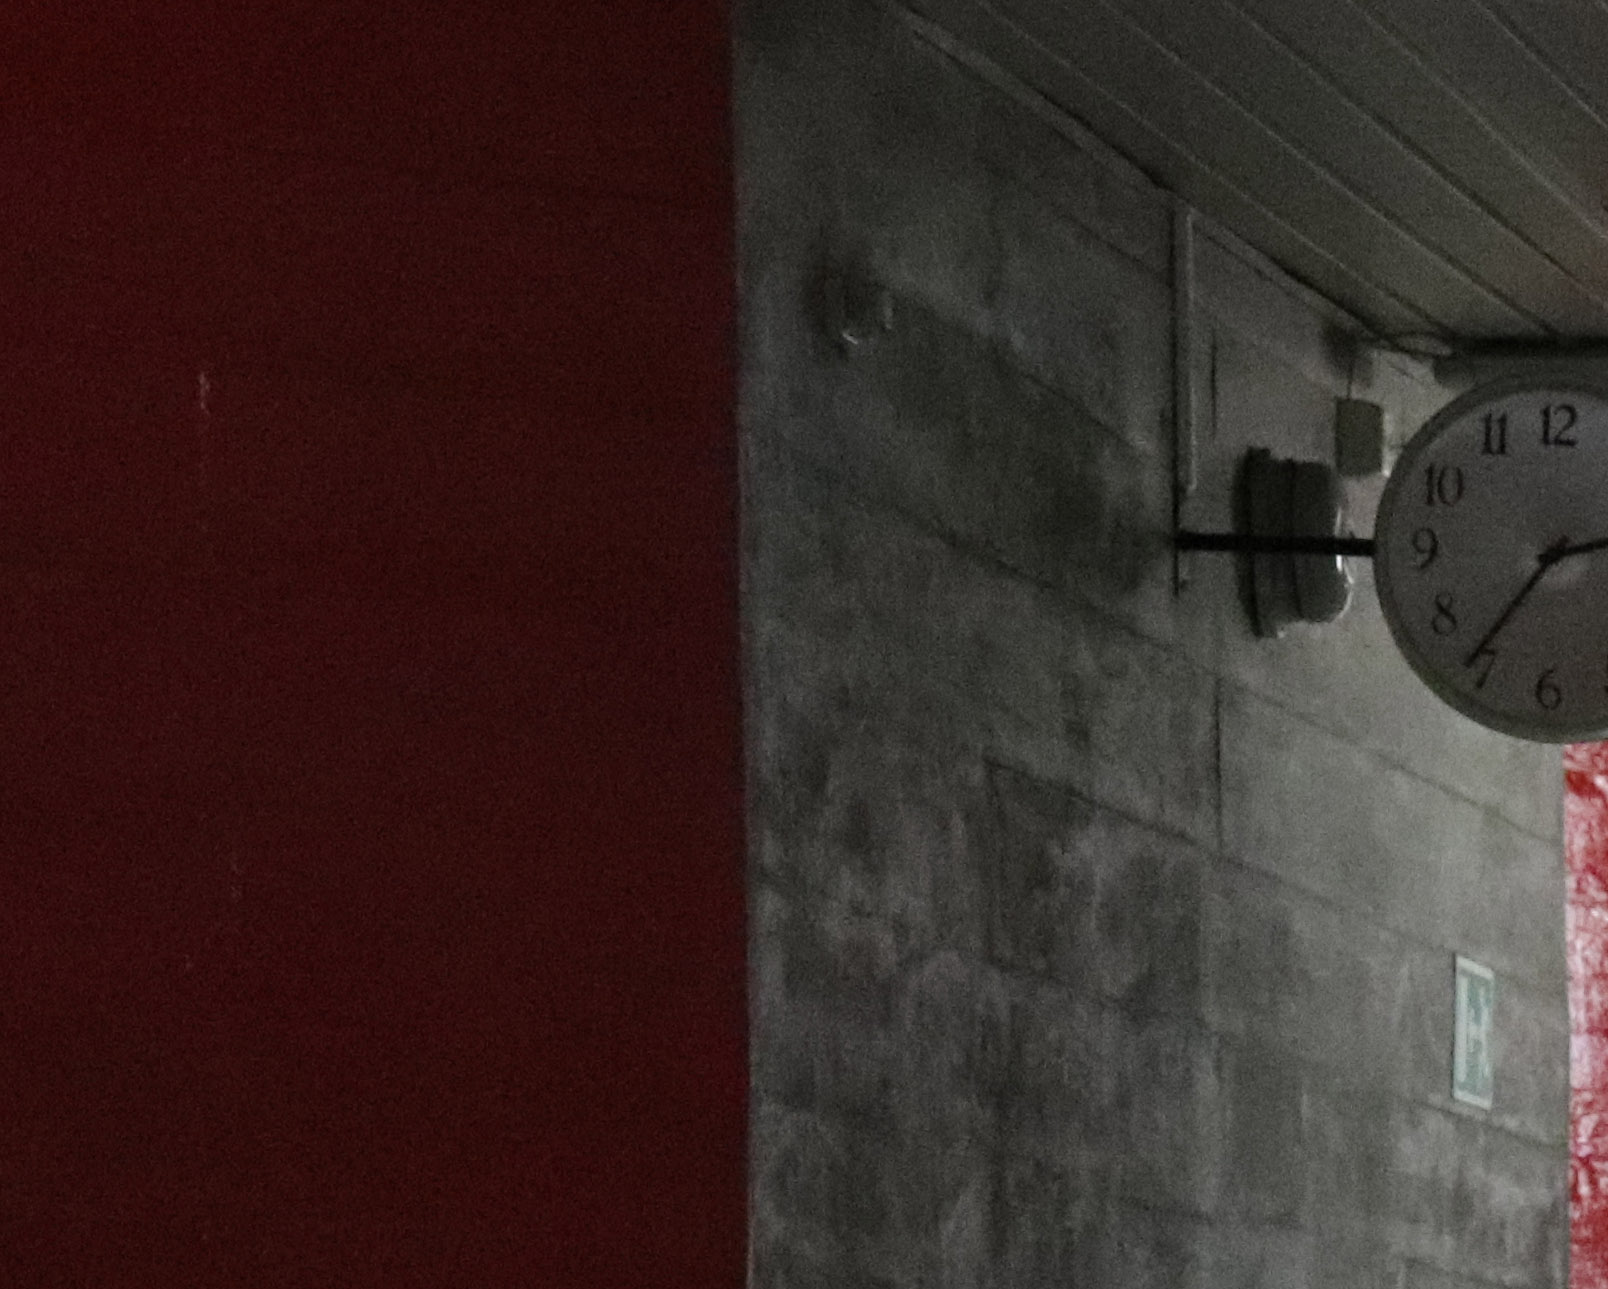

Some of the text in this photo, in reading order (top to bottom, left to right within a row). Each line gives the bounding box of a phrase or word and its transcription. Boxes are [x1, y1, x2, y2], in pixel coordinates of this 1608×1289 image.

[1481, 412, 1508, 456] 11
[1540, 404, 1577, 447] 12
[1424, 464, 1464, 507] 10
[1412, 528, 1439, 569] 9
[1431, 593, 1457, 636] 8
[1474, 649, 1497, 689] 7
[1535, 669, 1562, 710] 6
